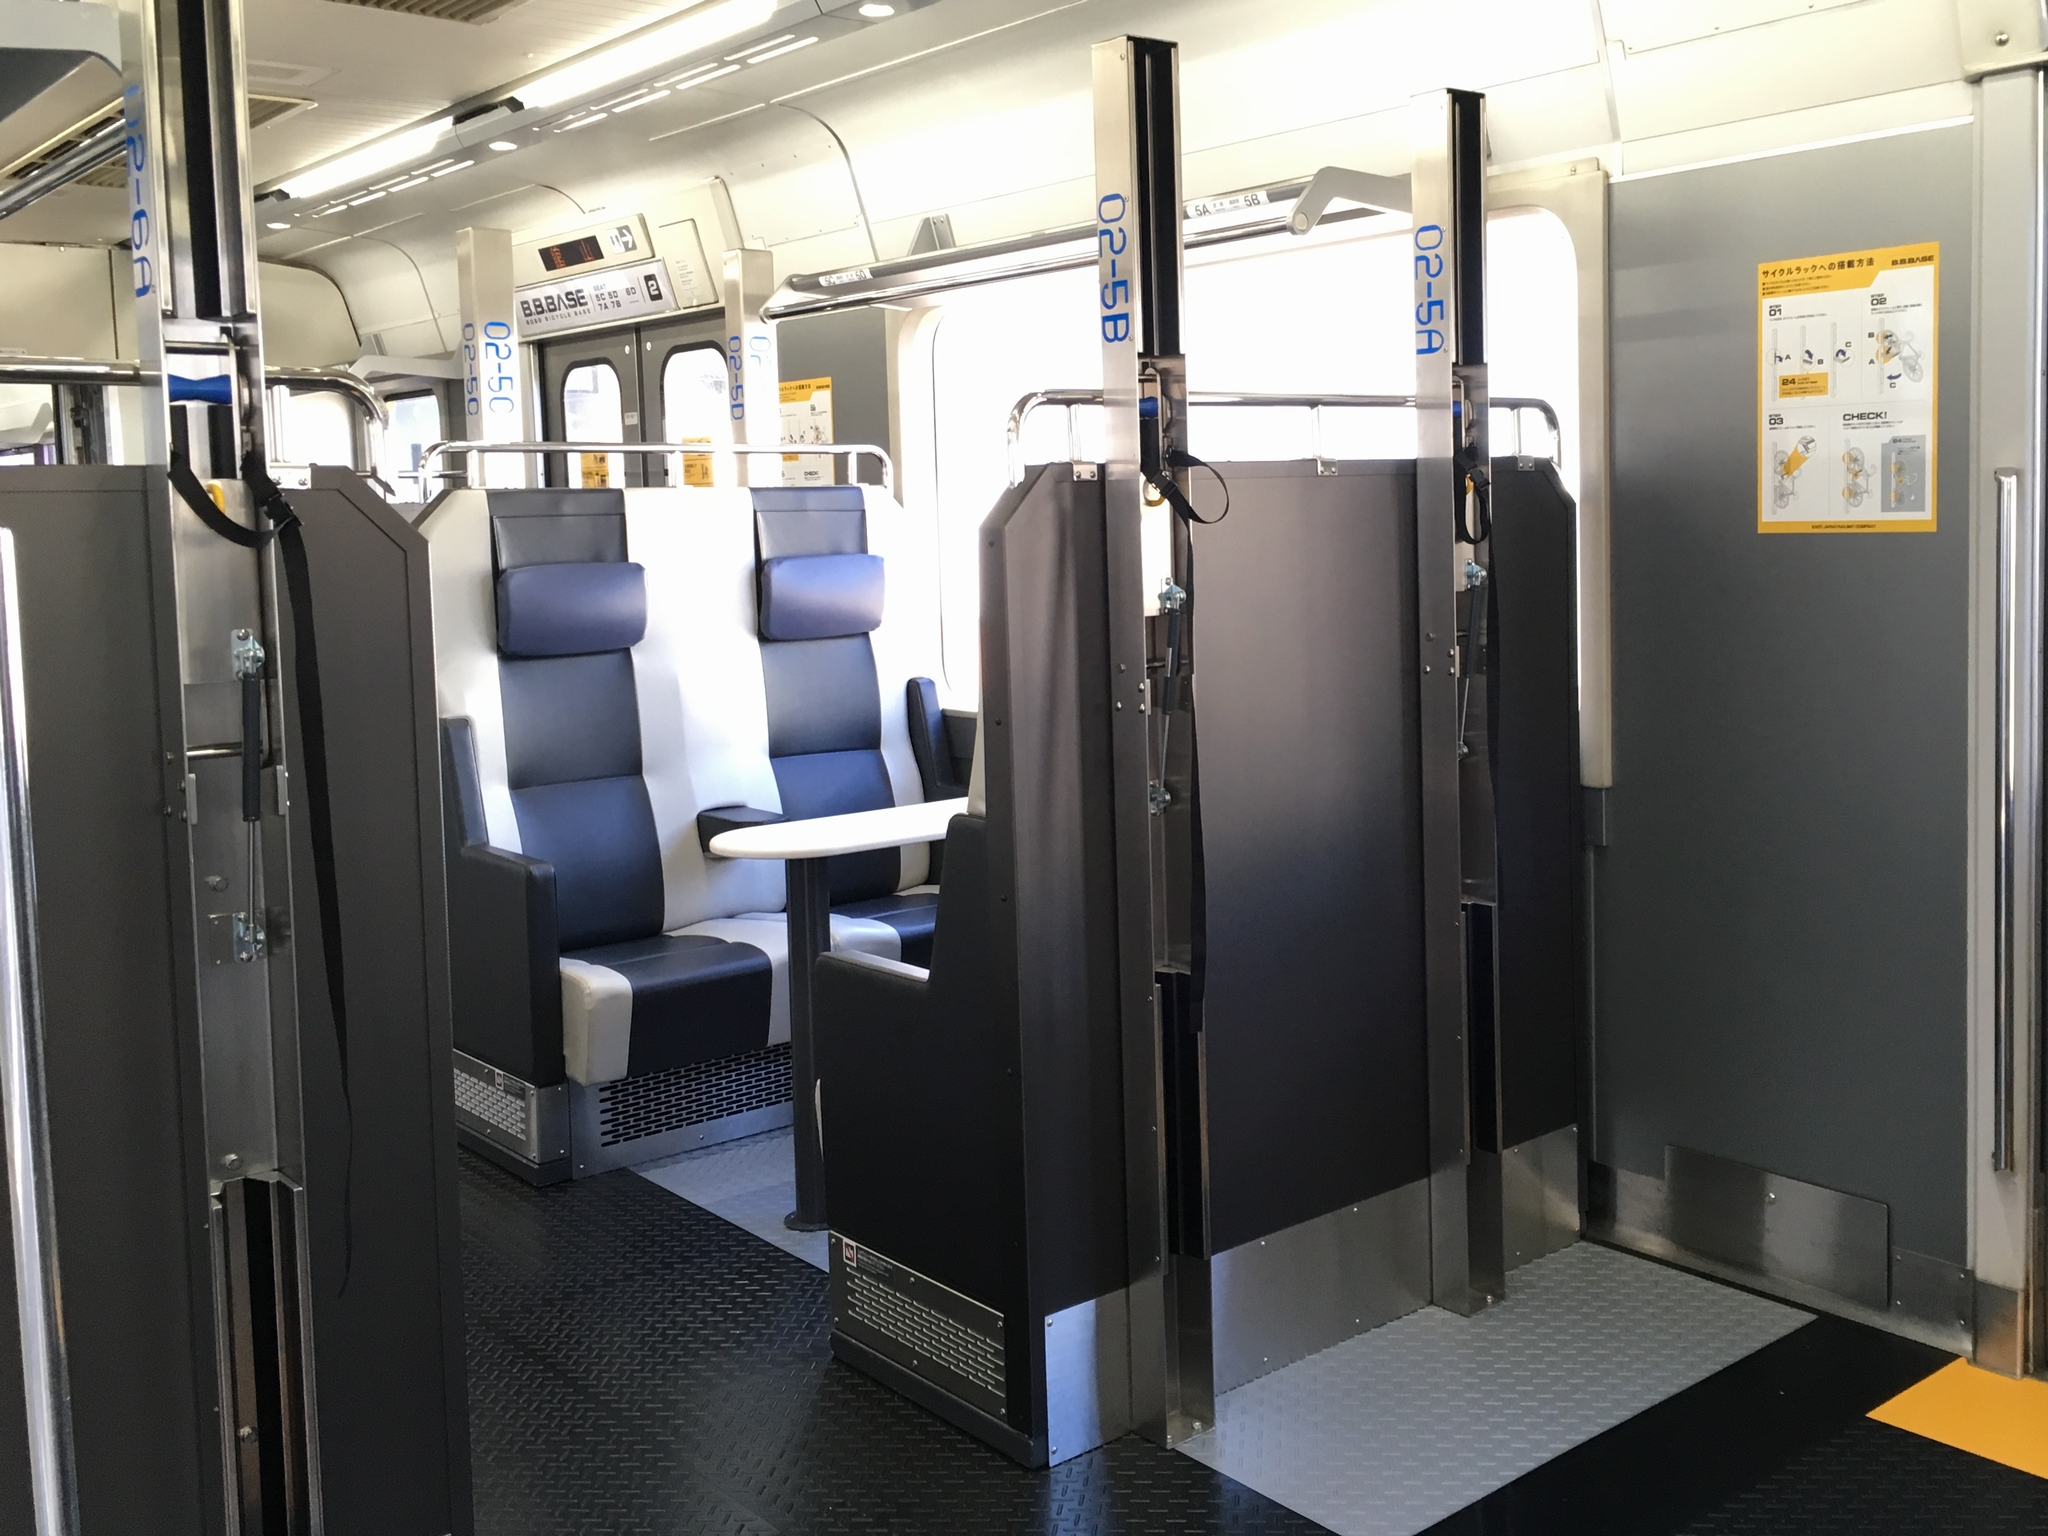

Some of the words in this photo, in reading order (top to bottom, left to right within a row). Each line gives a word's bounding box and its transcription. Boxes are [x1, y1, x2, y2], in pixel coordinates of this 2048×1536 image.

[124, 84, 153, 298] 02-6A
[1194, 203, 1212, 217] 5A
[1244, 193, 1261, 207] 5B
[1098, 193, 1130, 343] 02-5B
[595, 293, 606, 302] 5C
[647, 280, 659, 296] 2
[1415, 224, 1445, 355] 02-5A
[520, 289, 588, 318] B.B.BASE
[598, 302, 609, 311] 7A
[611, 300, 622, 309] 7B
[1871, 297, 1887, 306] 02
[1769, 308, 1782, 317] 01
[463, 323, 479, 415] 02-5C
[484, 321, 514, 413] 02-5C
[728, 336, 744, 420] 02-5D
[1782, 378, 1796, 386] 24
[1769, 417, 1784, 425] 03
[1843, 411, 1887, 421] CHECK!
